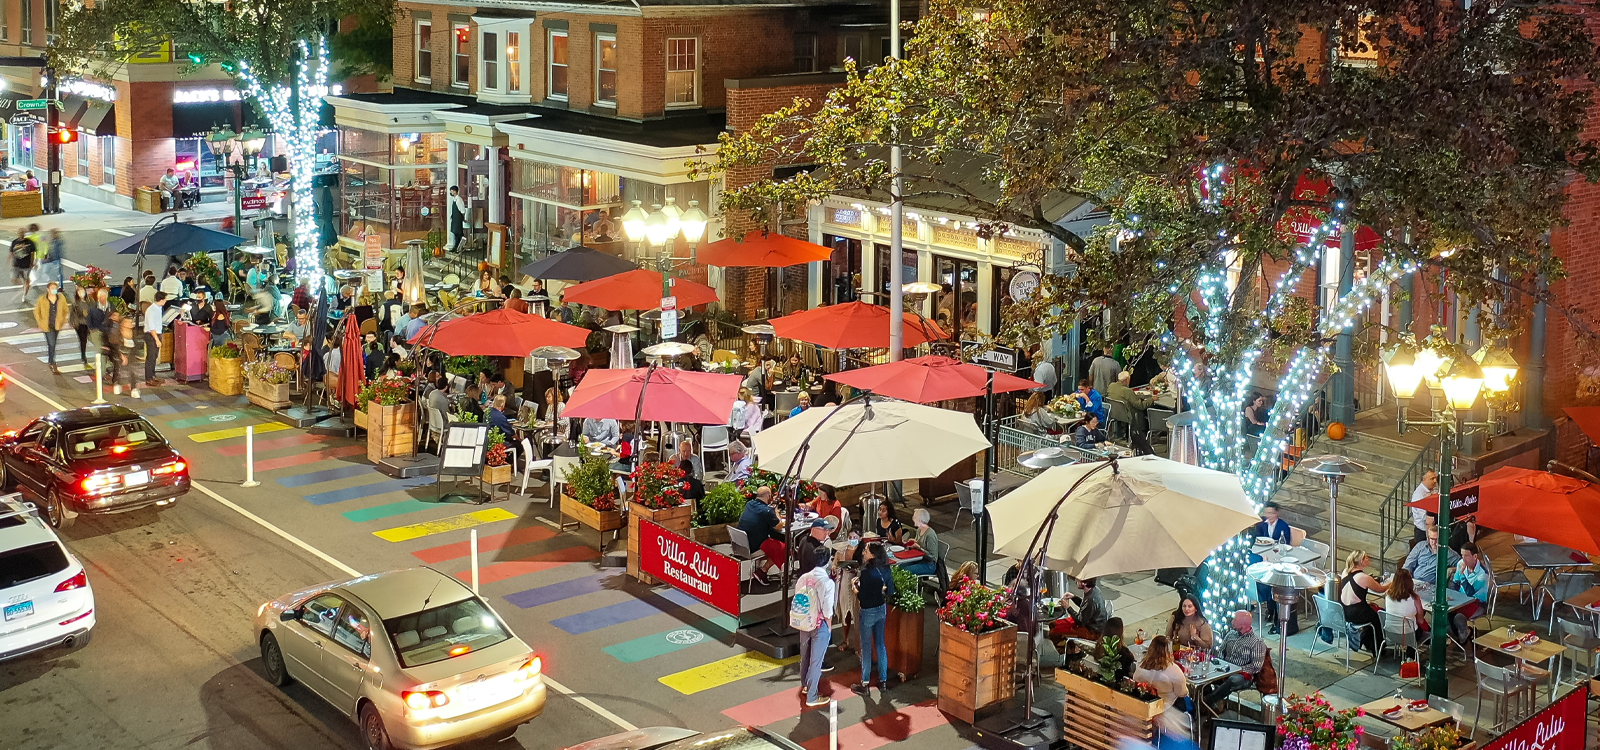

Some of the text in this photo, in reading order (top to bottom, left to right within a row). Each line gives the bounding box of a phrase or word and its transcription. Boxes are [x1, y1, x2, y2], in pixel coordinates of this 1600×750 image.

[1016, 280, 1035, 289] SOUTH
[993, 352, 1009, 363] WAY
[657, 535, 719, 580] Villa Lulu
[663, 560, 712, 595] Restaurant
[1531, 714, 1566, 750] Lulu
